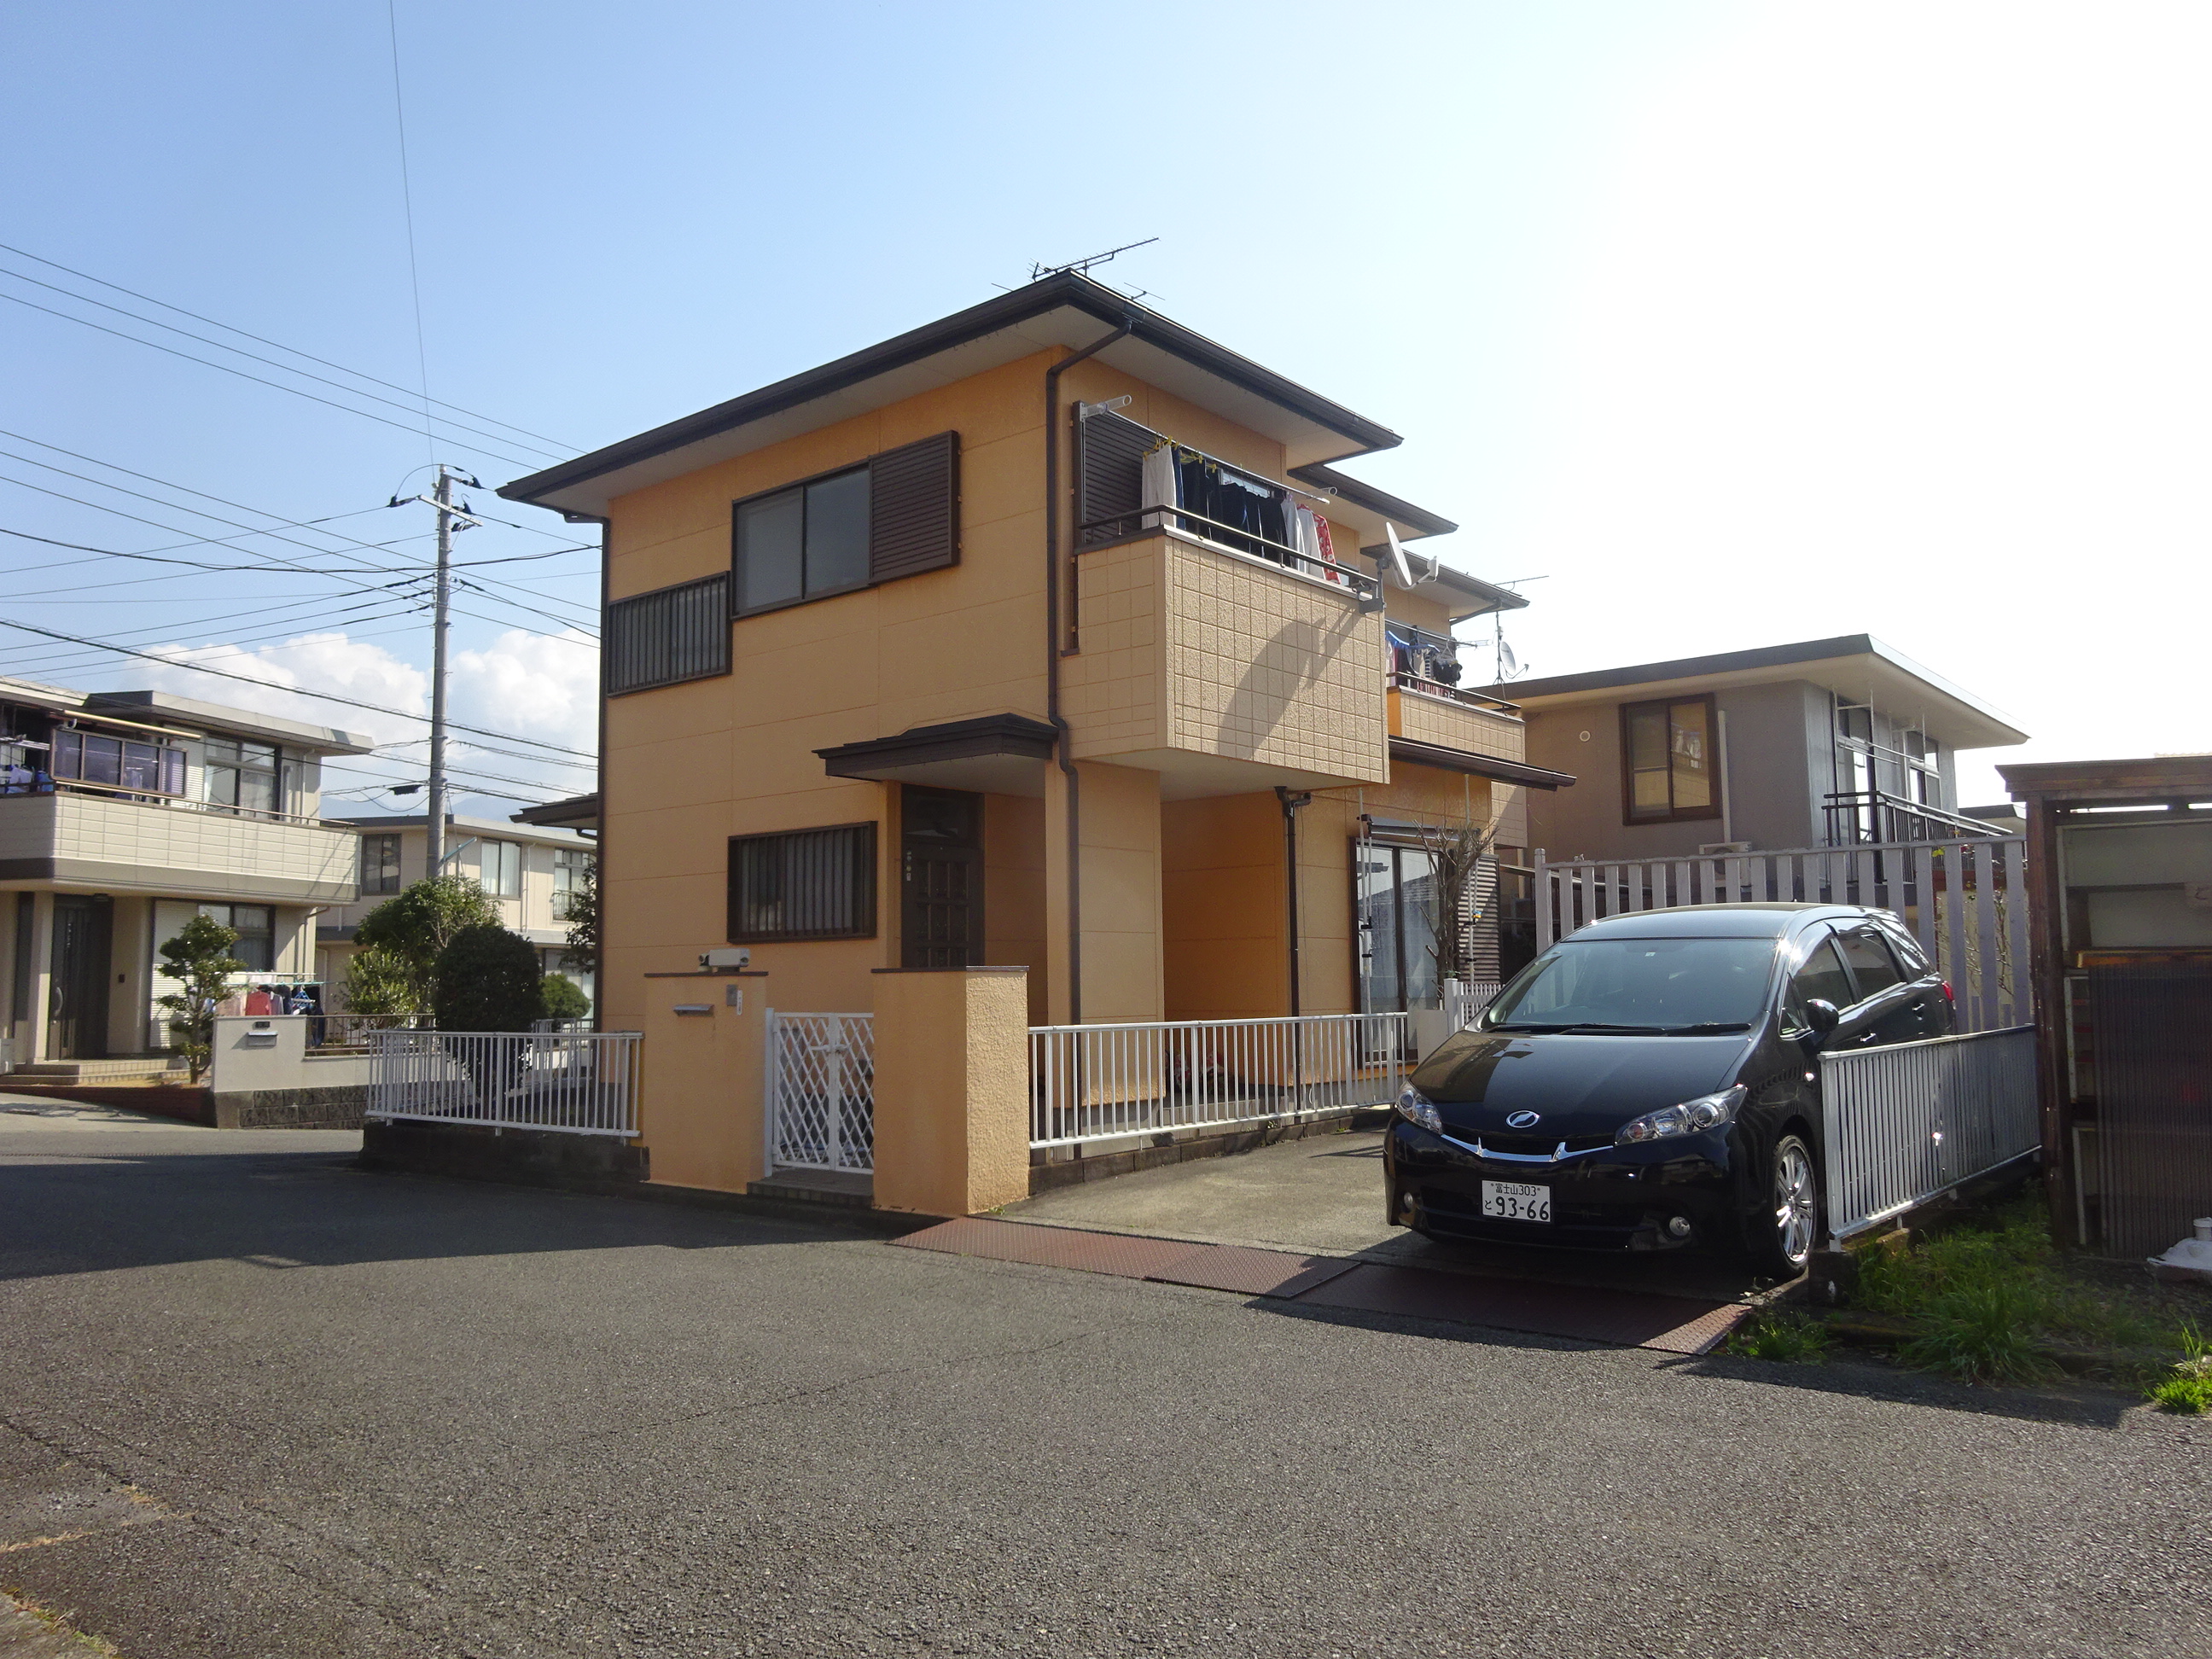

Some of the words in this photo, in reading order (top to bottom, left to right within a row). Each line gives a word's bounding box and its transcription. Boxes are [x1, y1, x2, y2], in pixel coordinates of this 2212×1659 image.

[1495, 1183, 1537, 1196] 富士山303
[1485, 1199, 1492, 1209] と
[1495, 1196, 1549, 1220] 93-66
